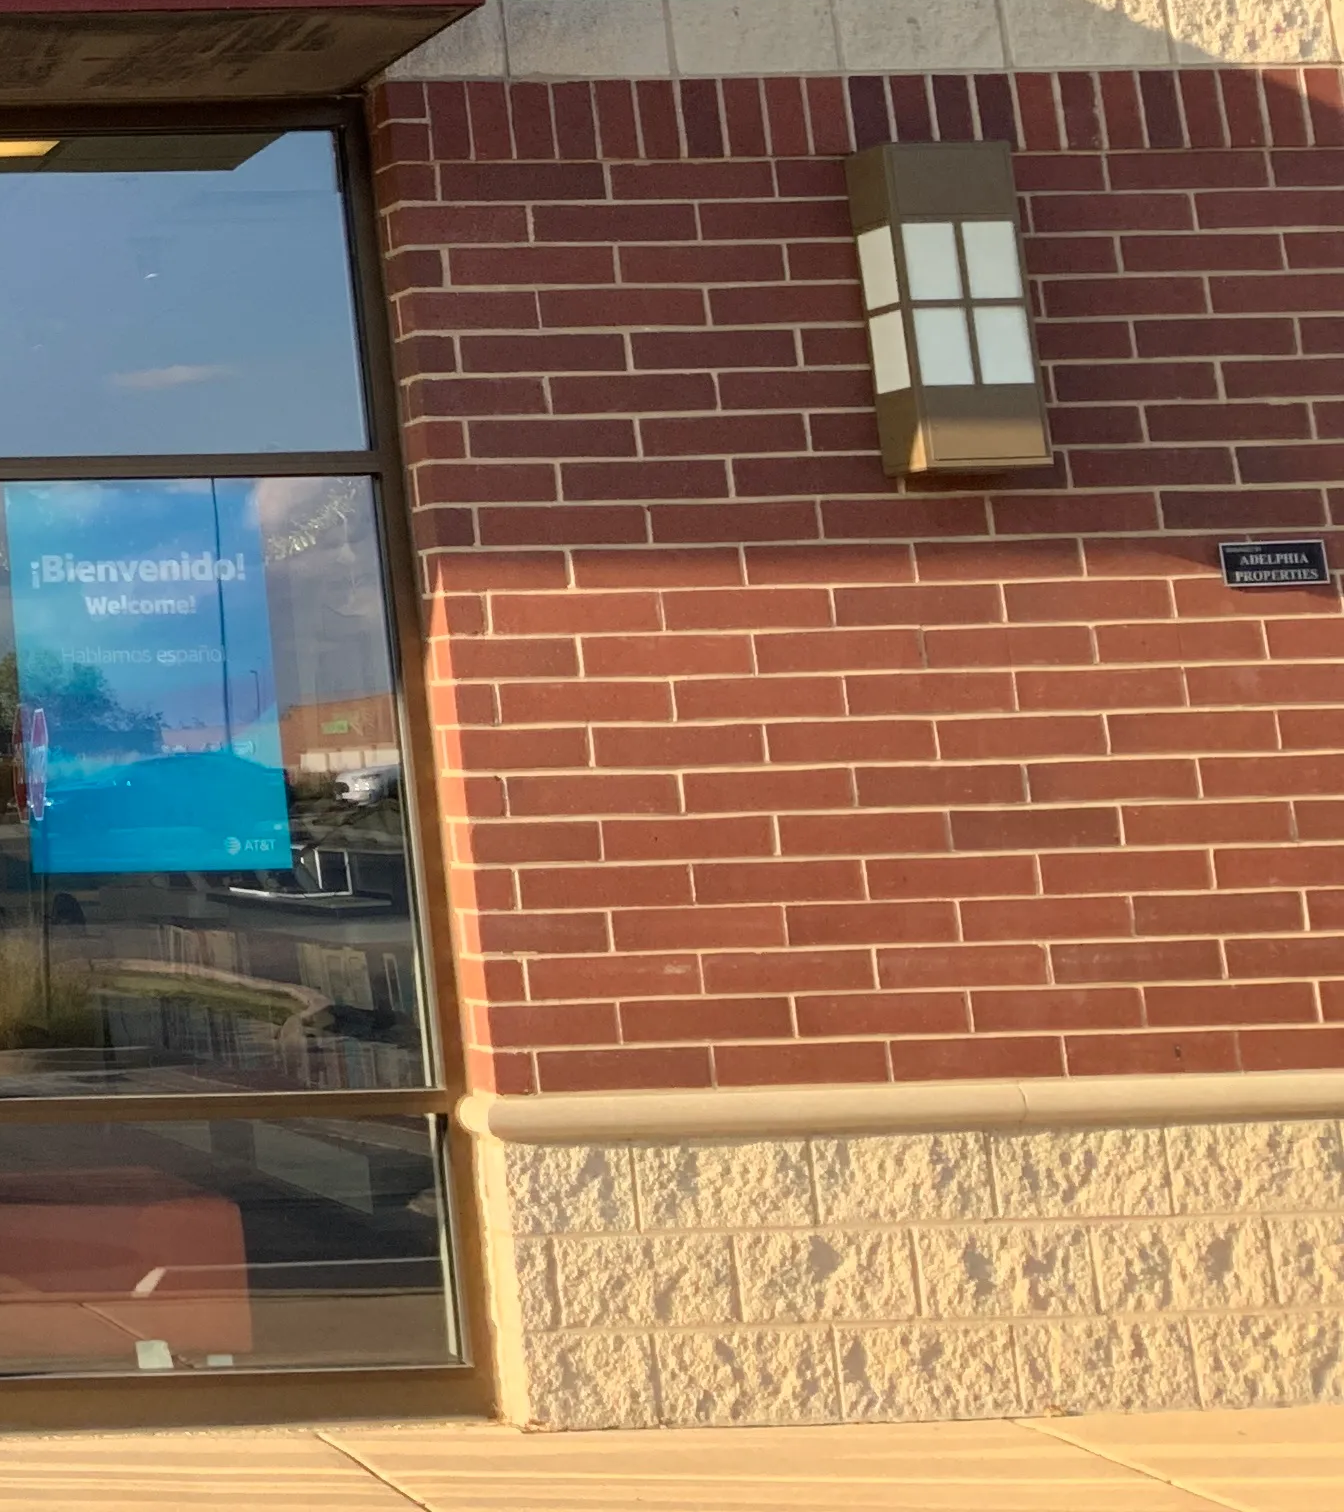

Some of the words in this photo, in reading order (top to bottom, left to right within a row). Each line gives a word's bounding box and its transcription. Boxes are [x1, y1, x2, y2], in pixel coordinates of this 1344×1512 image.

[1239, 552, 1309, 566] ADELPHIA
[31, 552, 246, 589] ¡Bienvenido!
[1234, 568, 1319, 583] PROPERTIES
[85, 594, 197, 616] Welcome!
[61, 645, 152, 664] Hablamos
[245, 838, 276, 851] AT&T
